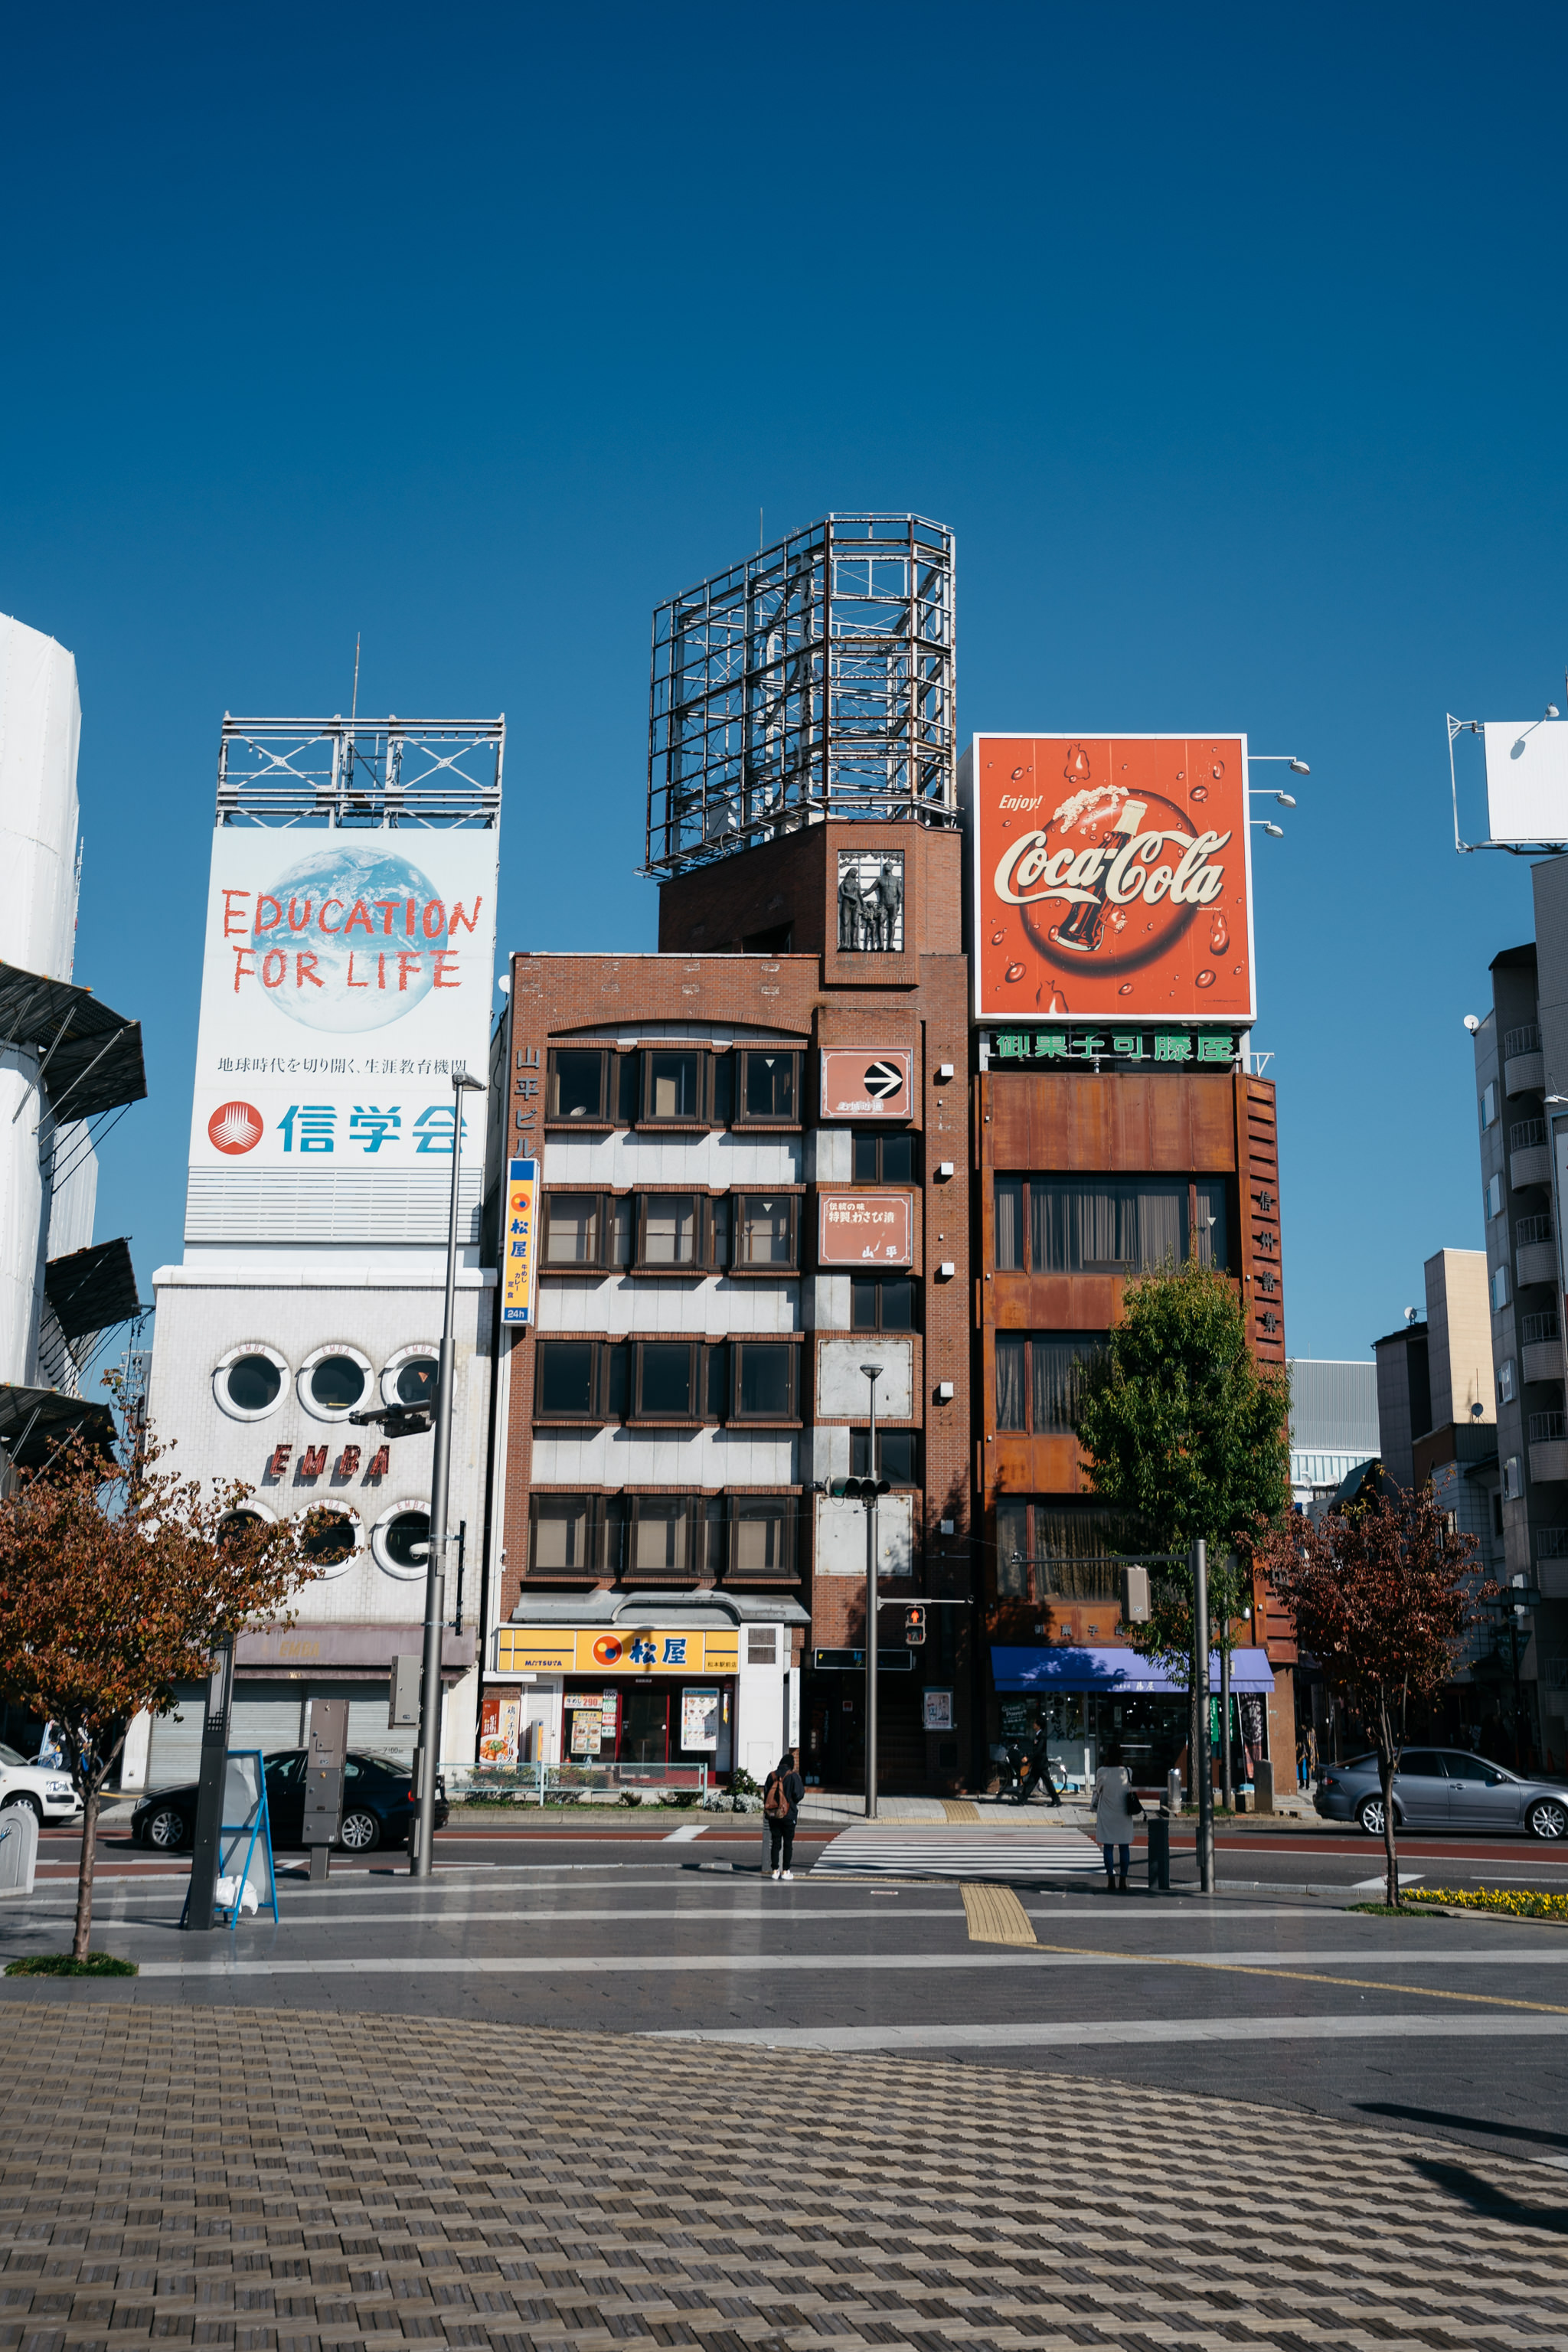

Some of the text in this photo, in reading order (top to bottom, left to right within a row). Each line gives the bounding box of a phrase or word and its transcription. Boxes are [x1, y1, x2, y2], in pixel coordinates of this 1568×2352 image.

[998, 795, 1043, 812] Enjoy!
[221, 889, 482, 939] EDUCATION
[233, 945, 462, 994] FOR LIFE
[514, 1046, 540, 1159] 山平ビル
[276, 1105, 469, 1154] 信学会
[829, 1202, 865, 1210] 伝統の味
[511, 1218, 528, 1257] 松屋
[1259, 1191, 1276, 1332] 信州銘菓
[507, 1280, 514, 1298] 定食
[507, 1309, 524, 1318] 24h
[237, 1344, 266, 1355] EMBA
[322, 1344, 350, 1355] EMBA
[405, 1344, 433, 1355] EMBA
[270, 1444, 390, 1475] EMBA
[397, 1500, 426, 1511] EMBA
[279, 1642, 320, 1657] EMBA
[629, 1638, 687, 1664] 松屋
